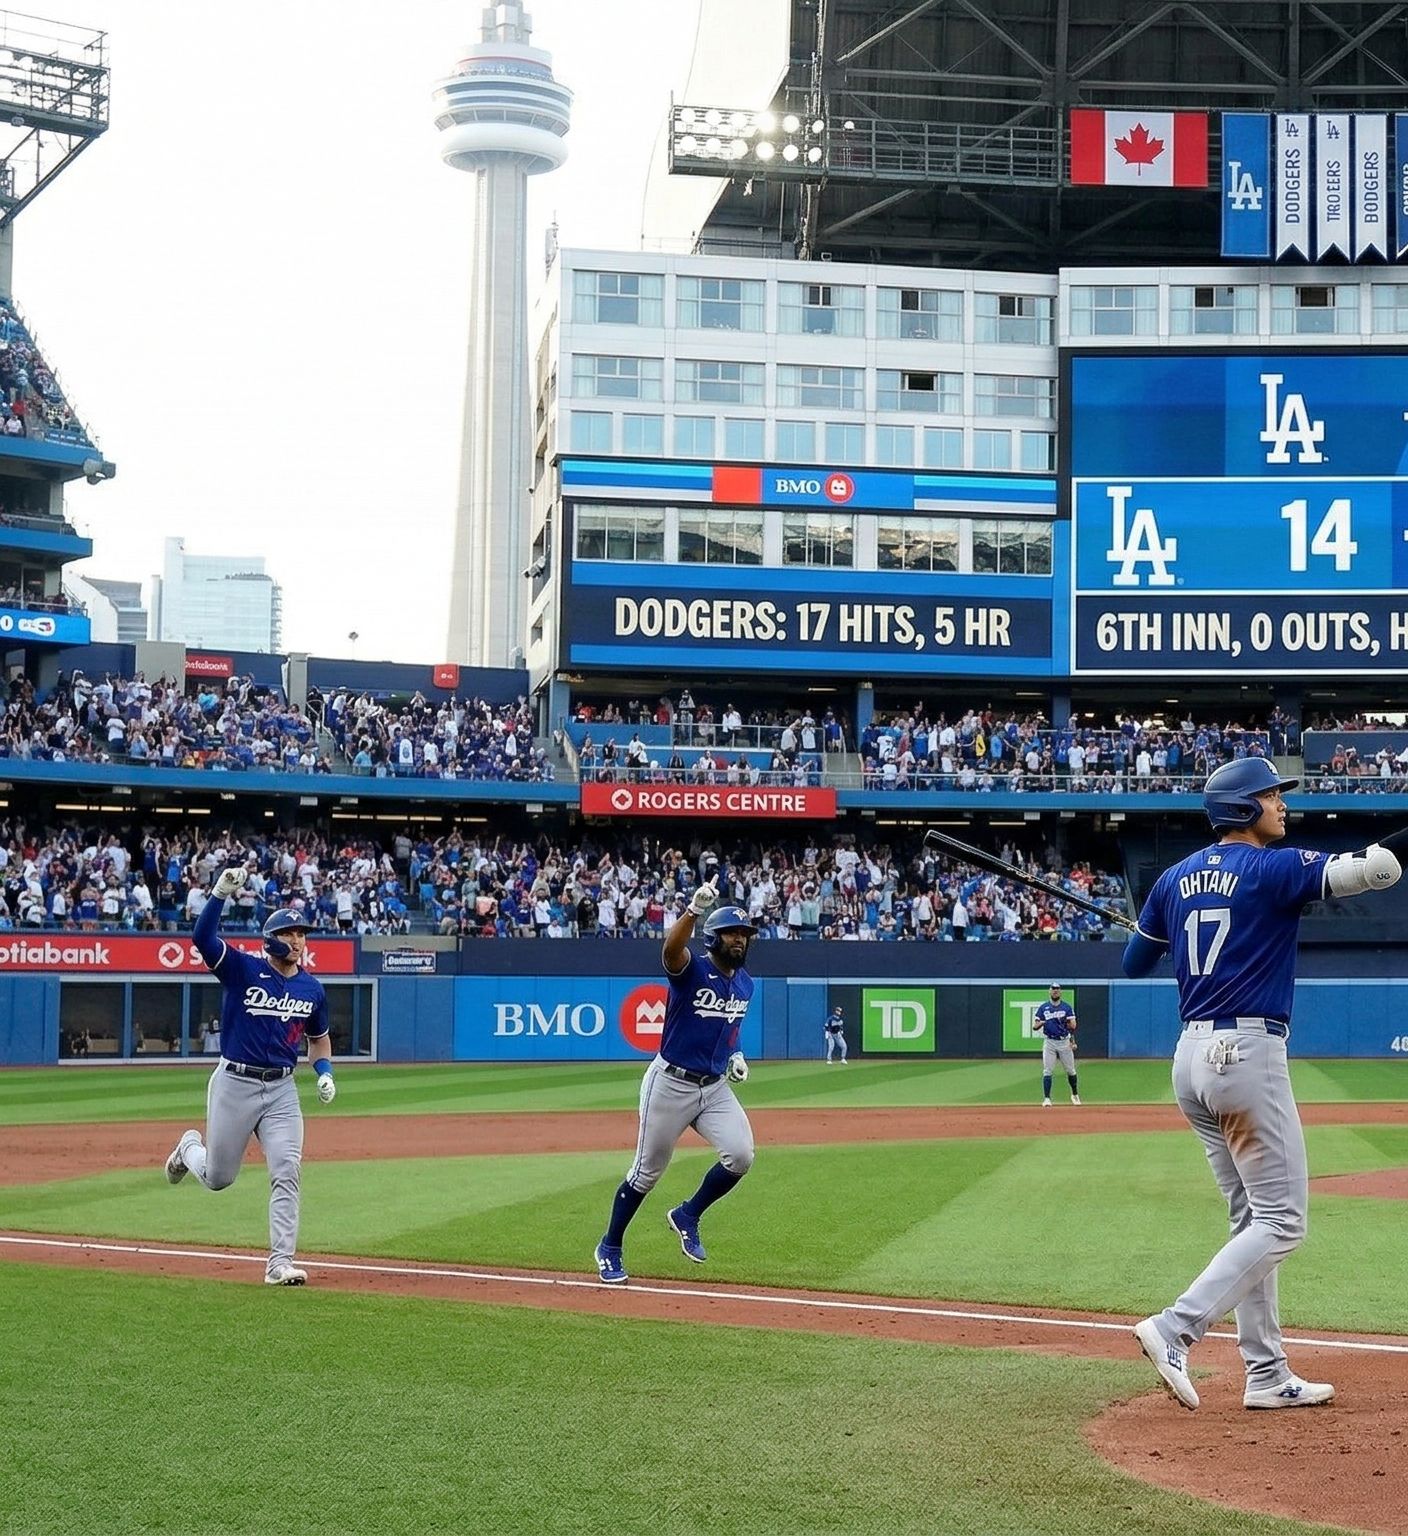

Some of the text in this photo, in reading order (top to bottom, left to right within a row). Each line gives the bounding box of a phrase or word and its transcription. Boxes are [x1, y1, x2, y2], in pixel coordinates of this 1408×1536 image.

[1285, 119, 1299, 137] LA
[1228, 161, 1263, 210] LA
[1285, 149, 1301, 223] DODGERS
[1363, 151, 1379, 223] BODGERS
[1260, 373, 1325, 463] LA
[776, 479, 820, 495] BMO
[1106, 486, 1177, 585] LA
[1280, 499, 1358, 571] 14
[615, 597, 1011, 651] DODGERS: 17 HITS, 5 HR
[1096, 612, 1160, 651] 6TH
[1172, 612, 1242, 657] INN,
[1280, 612, 1380, 656] OUTS,
[638, 791, 805, 811] ROGERS CENTRE
[1179, 870, 1239, 899] OHTANI
[1184, 907, 1231, 976] 17
[493, 1003, 606, 1037] BMO
[870, 1000, 927, 1037] TD
